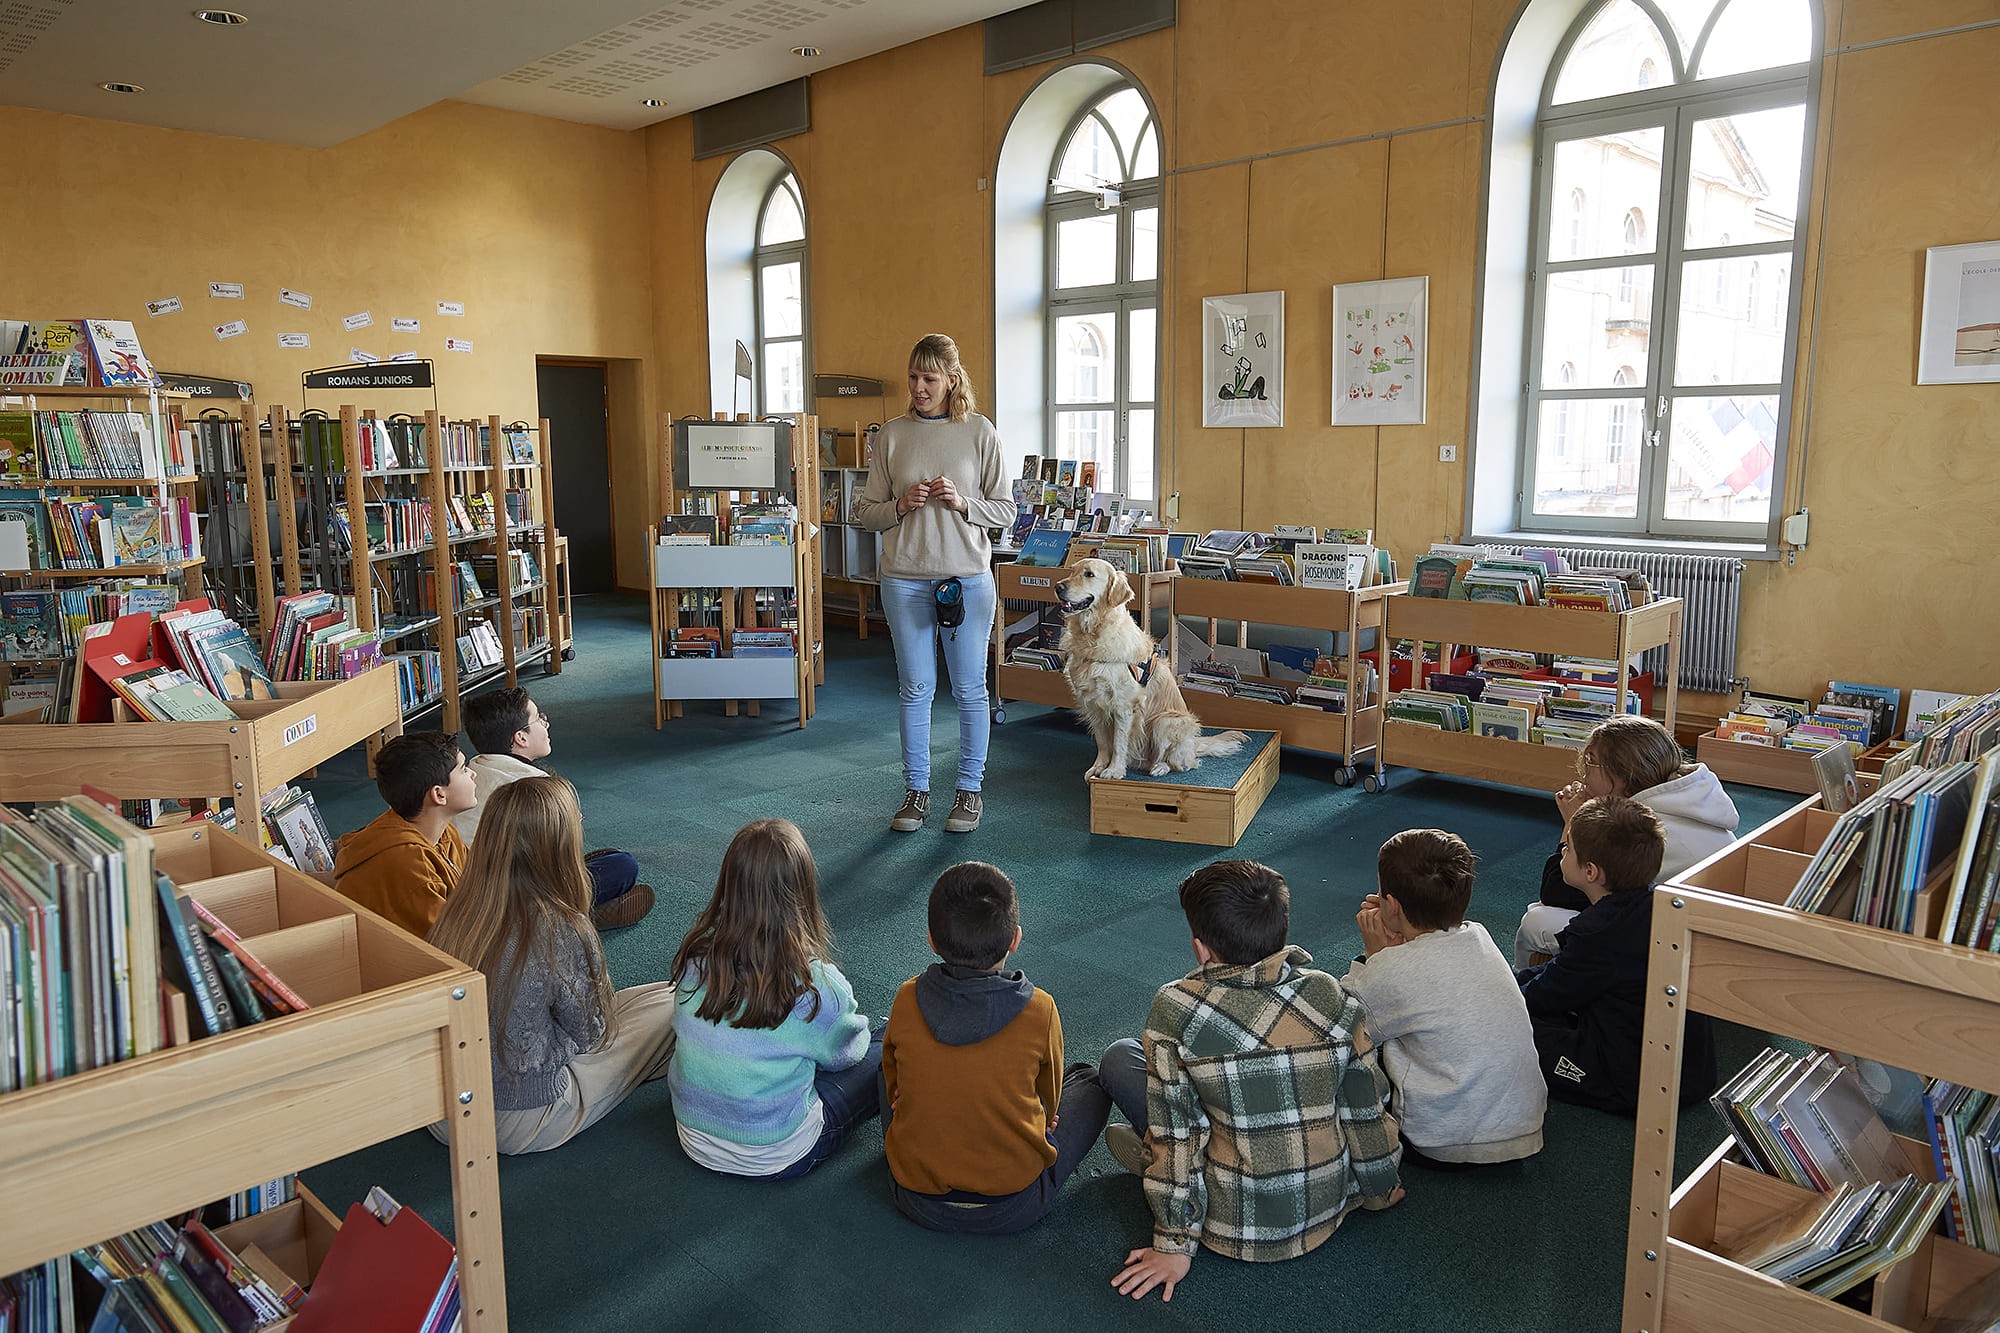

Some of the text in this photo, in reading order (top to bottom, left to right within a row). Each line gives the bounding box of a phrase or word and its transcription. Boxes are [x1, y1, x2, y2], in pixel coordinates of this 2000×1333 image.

[327, 375, 414, 387] ROMANS JUNIORS
[838, 386, 858, 395] REVUES
[1301, 552, 1346, 562] DRAGONS
[1304, 564, 1345, 580] ROSEMONDE
[1022, 577, 1049, 586] ALBUMS
[286, 717, 315, 743] CONTES
[1824, 720, 1863, 733] maison
[188, 923, 207, 955] SABLES
[199, 955, 212, 972] DES
[205, 972, 218, 988] ROI
